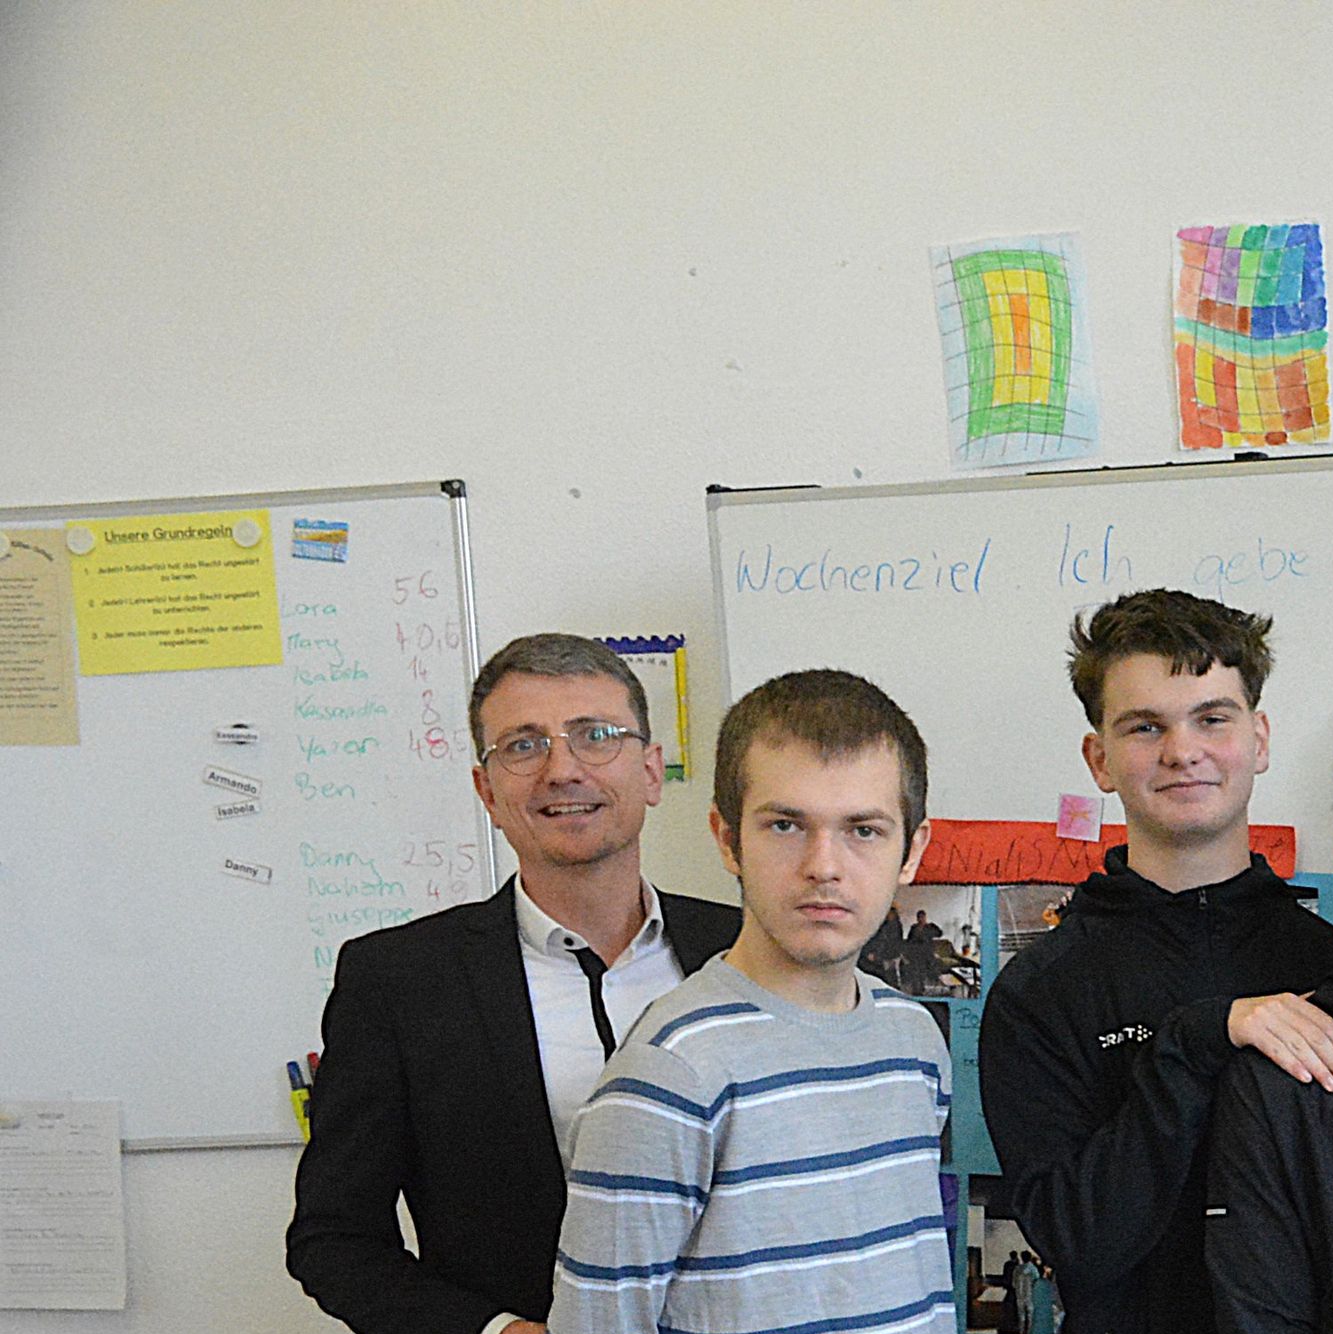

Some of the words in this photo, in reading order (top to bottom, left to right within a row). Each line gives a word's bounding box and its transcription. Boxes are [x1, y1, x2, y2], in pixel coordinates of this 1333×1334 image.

[104, 530, 150, 544] Unsere
[152, 524, 233, 541] Grundregeln
[736, 537, 992, 595] Wochenziel
[1058, 523, 1133, 587] Ich
[1192, 536, 1309, 606] gebe
[393, 570, 439, 605] 56
[208, 771, 257, 795] Armando
[217, 803, 255, 817] Isabela
[224, 859, 259, 877] Danny
